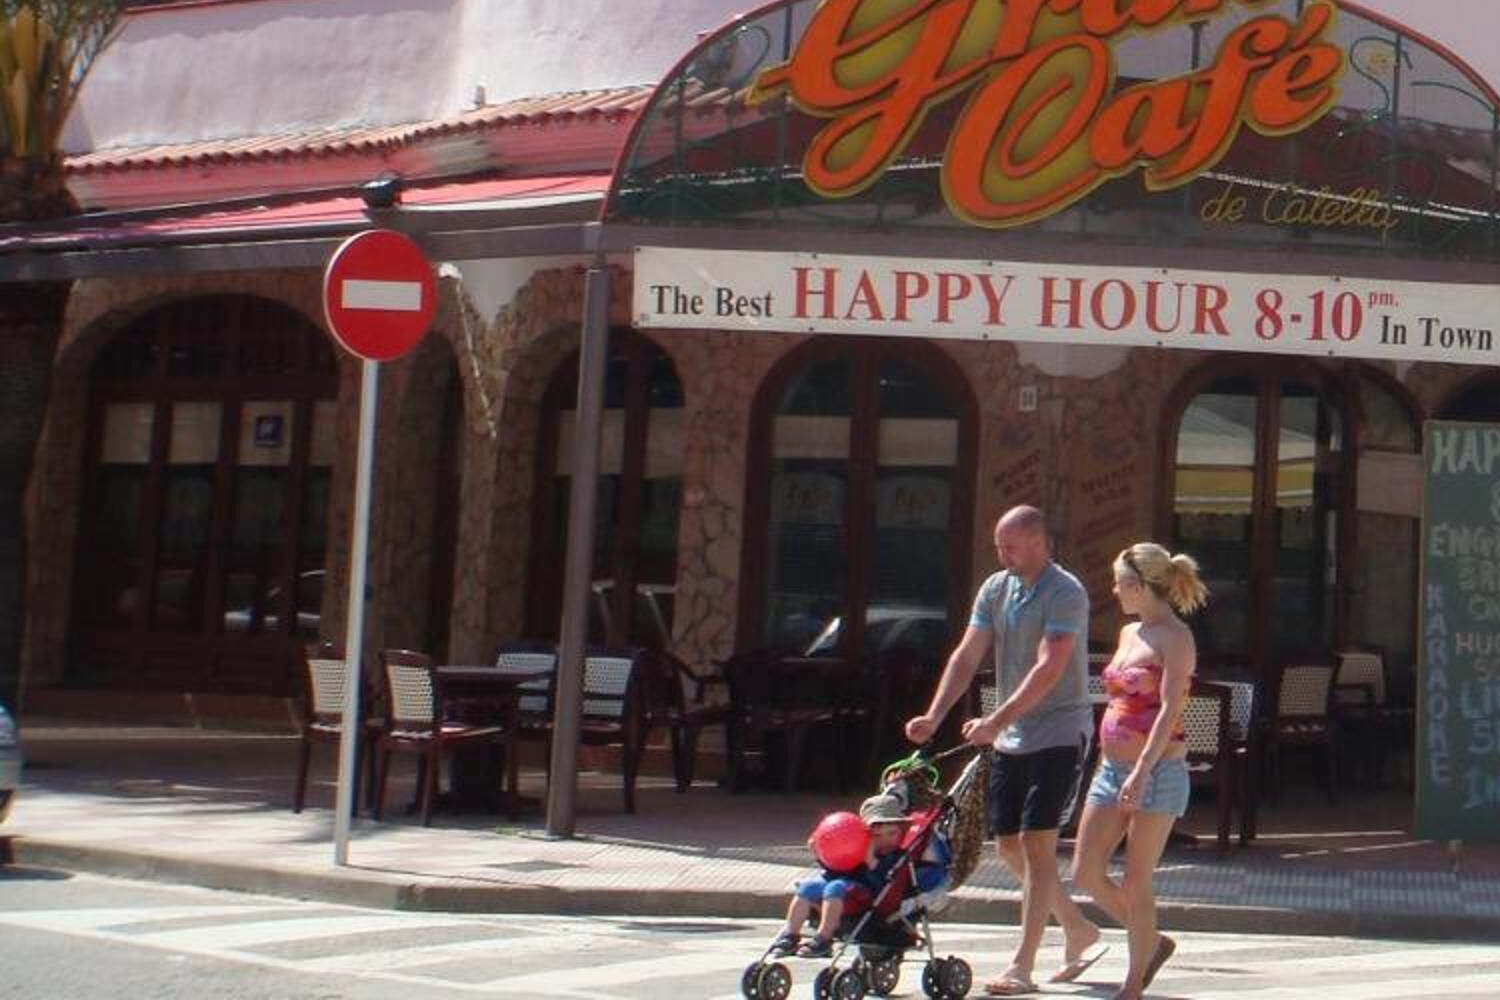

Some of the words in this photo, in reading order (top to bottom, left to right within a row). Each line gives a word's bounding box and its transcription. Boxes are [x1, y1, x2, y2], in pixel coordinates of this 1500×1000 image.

[943, 2, 1342, 226] Café
[650, 285, 703, 315] The
[715, 287, 775, 318] Best
[792, 267, 1015, 326] HAPPY
[1040, 277, 1231, 337] HOUR
[1254, 288, 1363, 342] 8-10
[1378, 314, 1406, 346] In
[1418, 316, 1494, 351] Town
